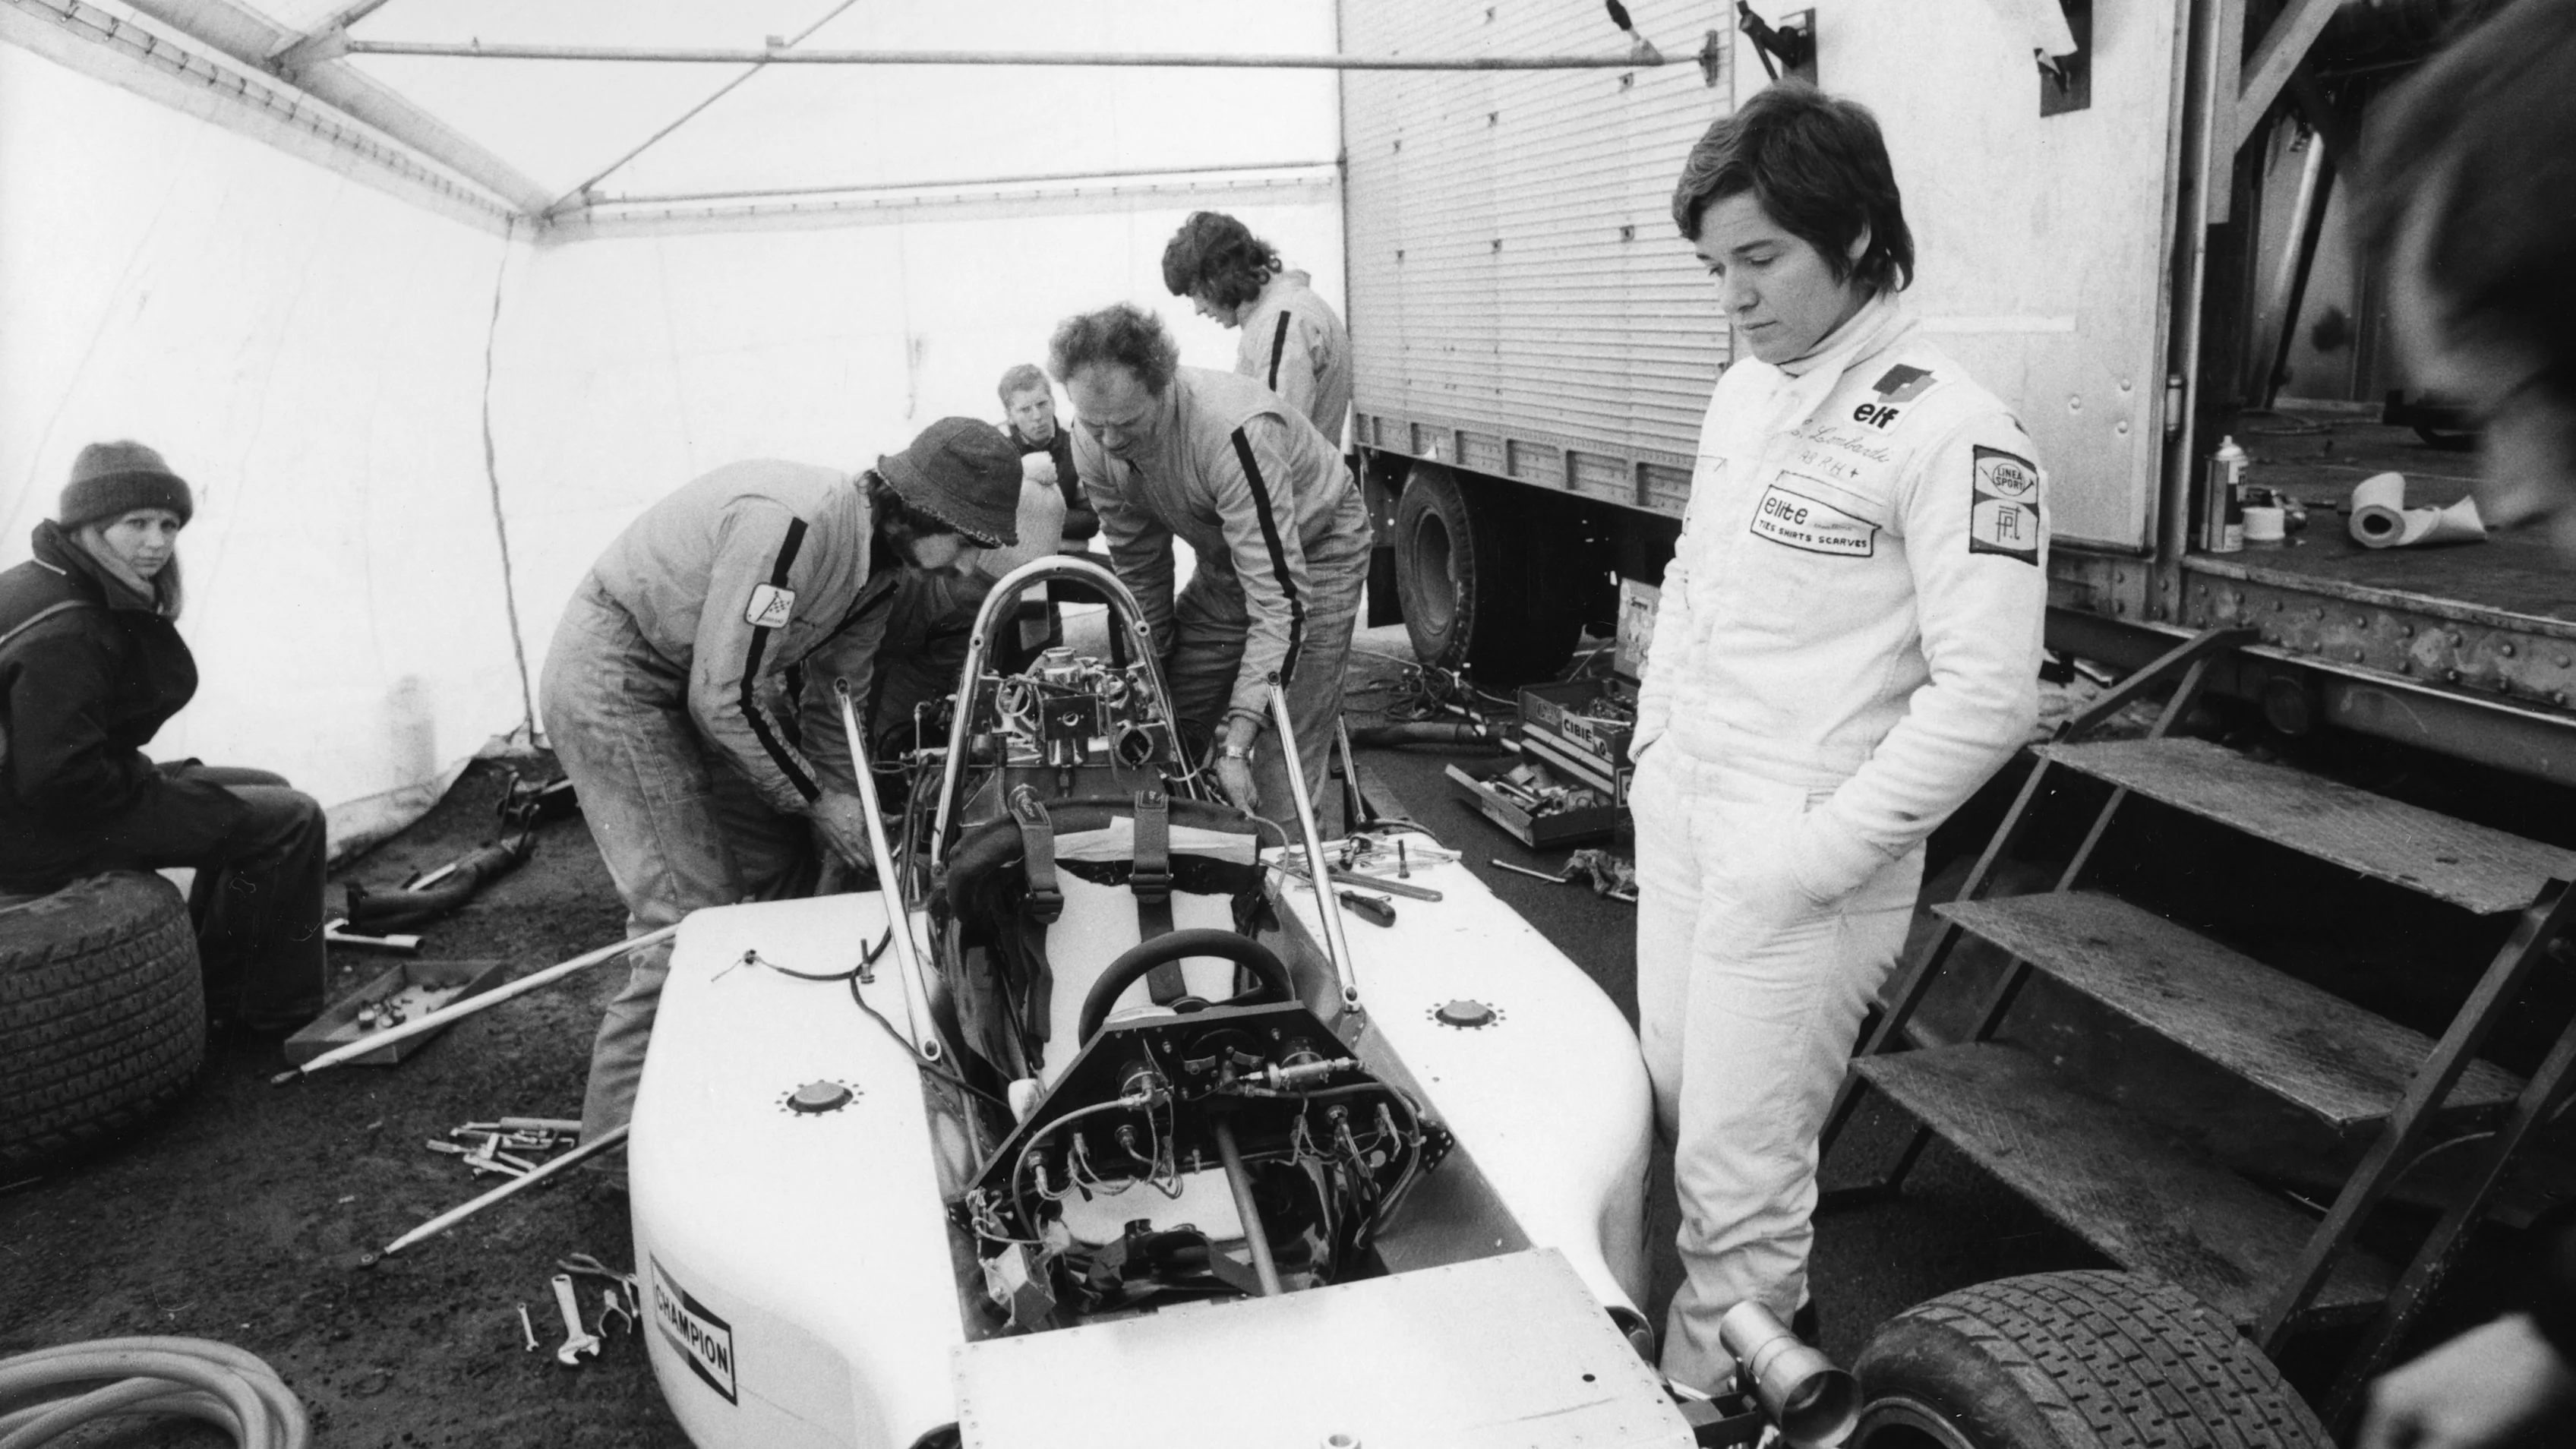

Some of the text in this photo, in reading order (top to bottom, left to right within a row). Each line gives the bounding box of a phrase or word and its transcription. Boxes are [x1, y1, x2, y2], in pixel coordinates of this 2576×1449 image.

[1853, 403, 1899, 430] elf
[1995, 476, 2023, 491] SPORT
[1764, 497, 1807, 525] elite
[1778, 527, 1812, 542] SHIRTS
[1818, 535, 1867, 548] SCARVES
[655, 1283, 729, 1374] CHAMPION
